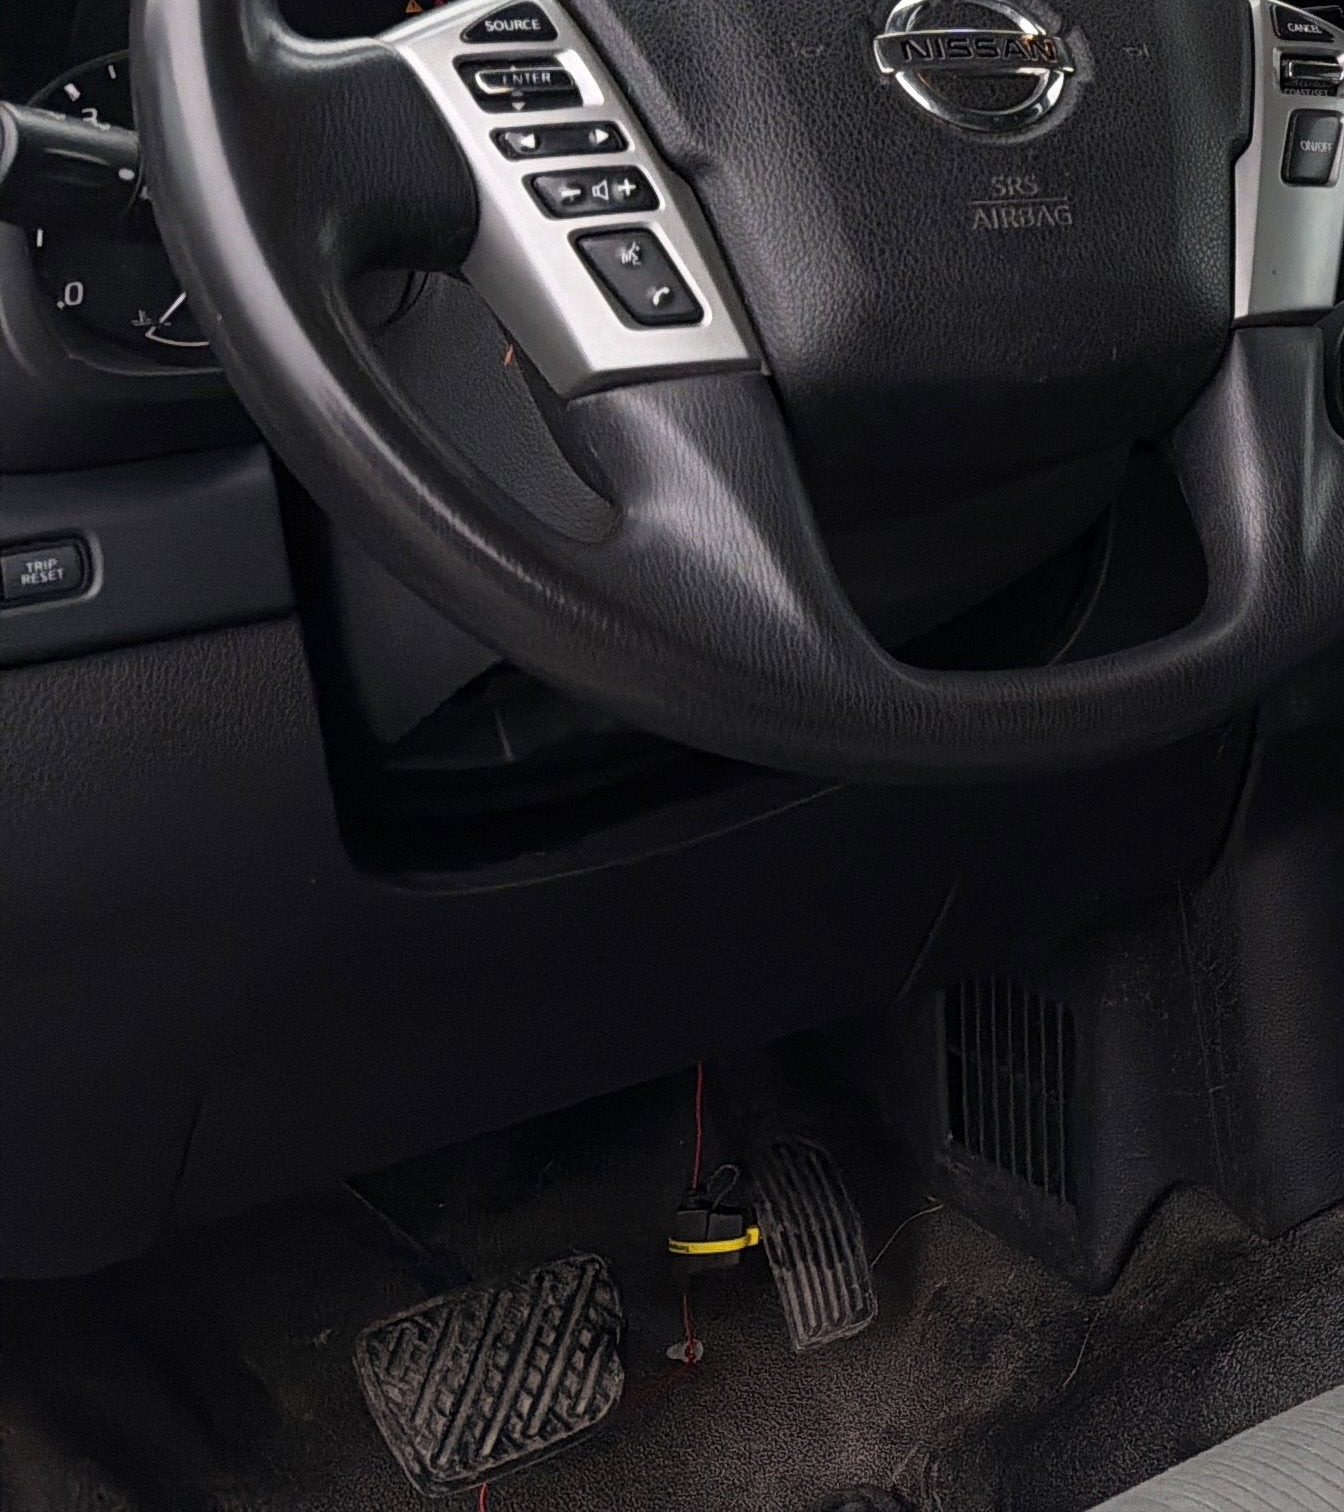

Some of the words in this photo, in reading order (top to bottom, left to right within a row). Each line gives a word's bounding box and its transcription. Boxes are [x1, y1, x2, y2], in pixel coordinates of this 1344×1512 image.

[484, 17, 542, 33] SOURCE
[1287, 23, 1322, 34] CANCEL
[900, 37, 1058, 64] NISSAN
[501, 71, 553, 87] ENTER
[1300, 140, 1333, 152] ON/OFF
[991, 174, 1039, 197] SRS
[26, 558, 58, 573] TRIP
[20, 568, 65, 586] RESET
